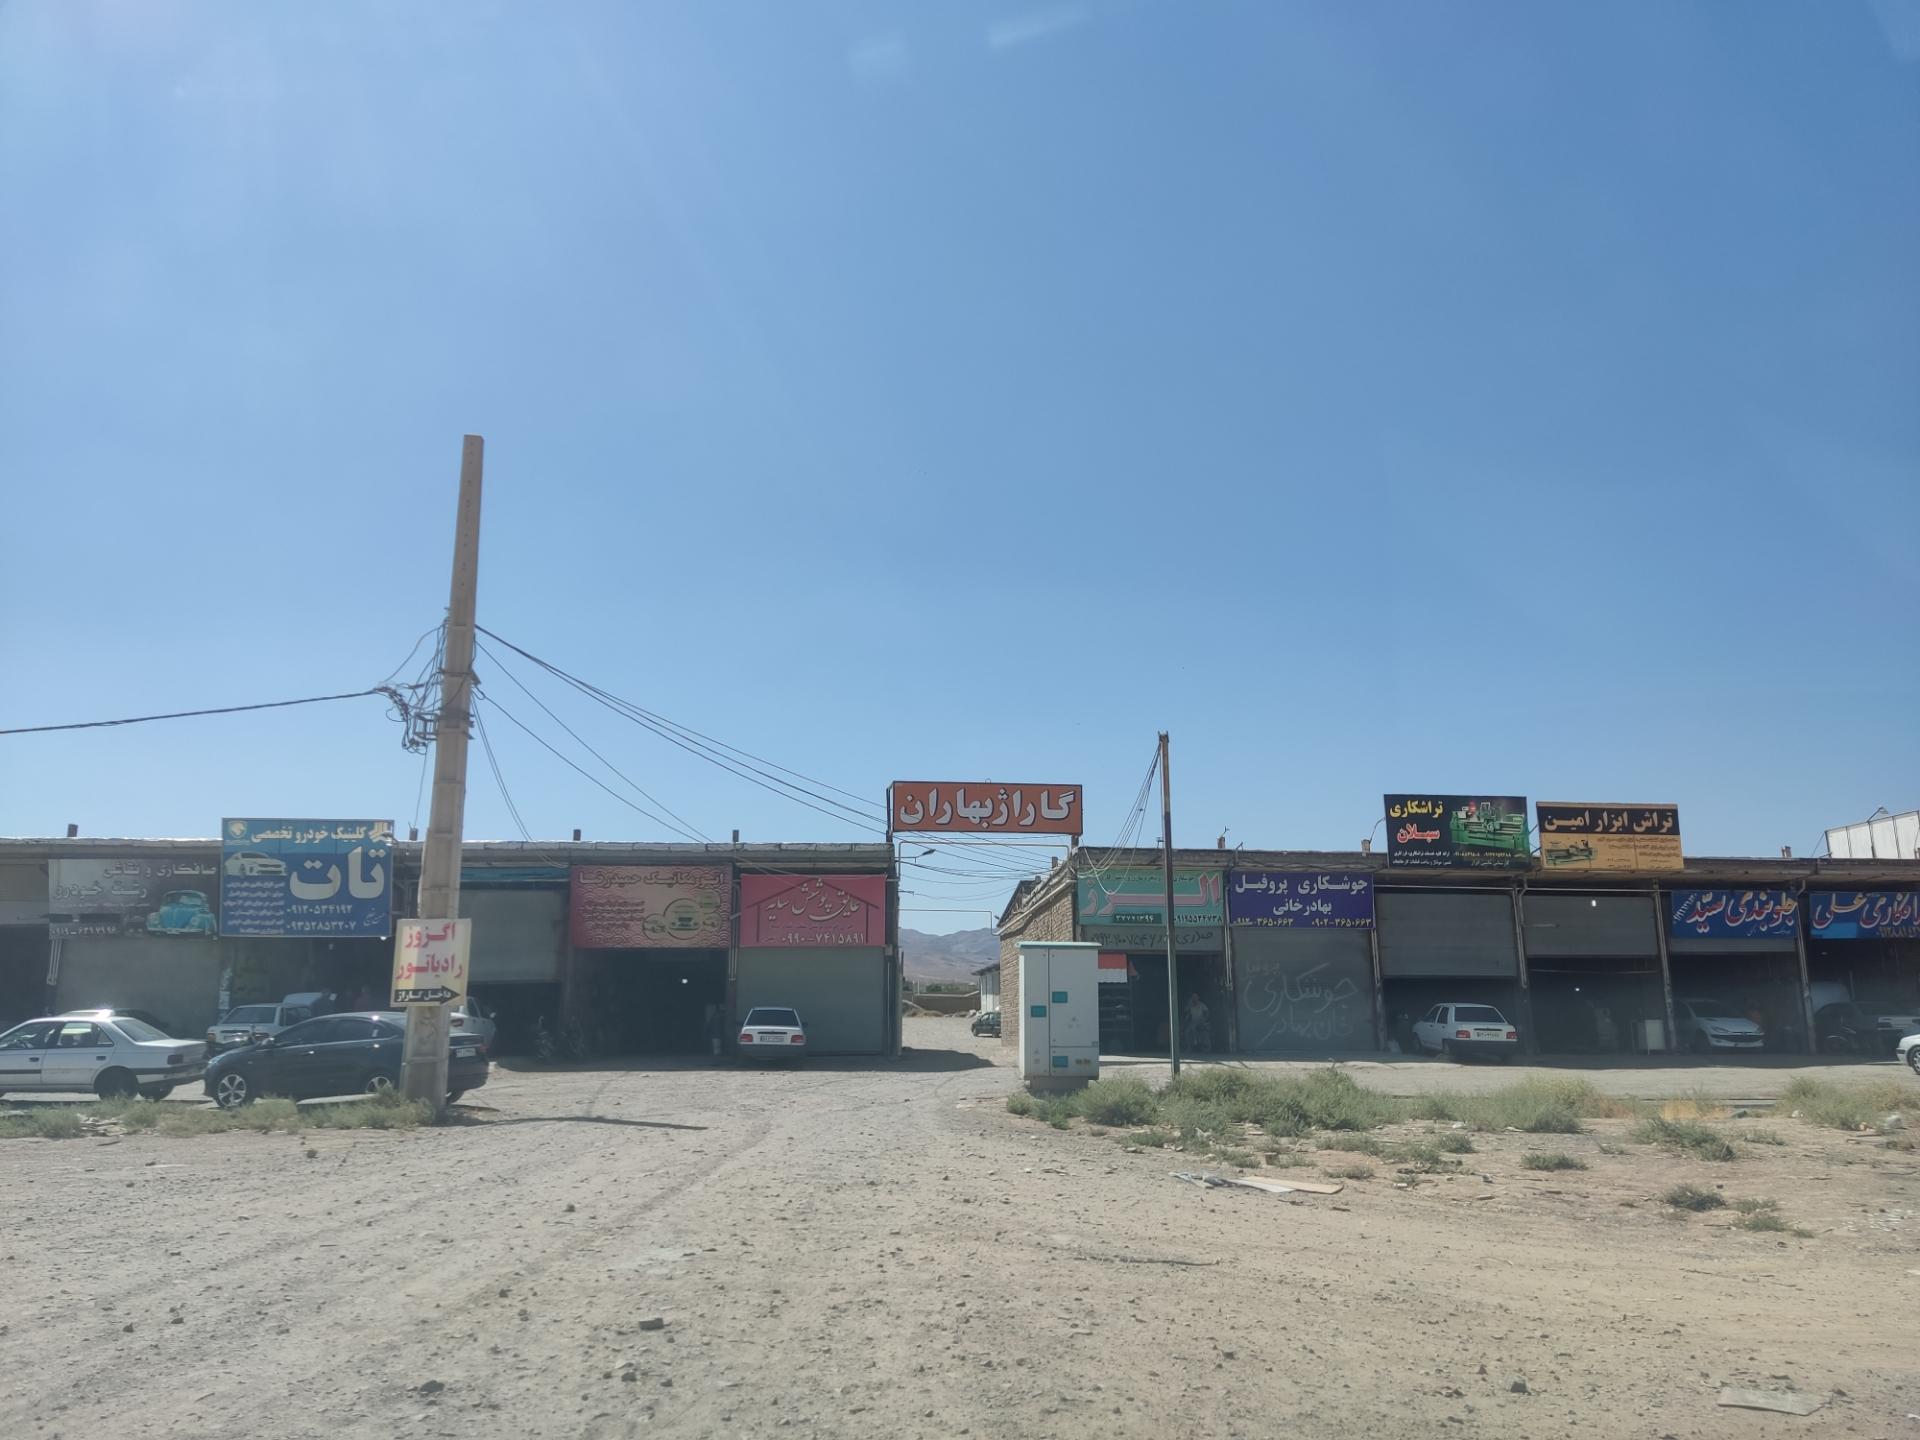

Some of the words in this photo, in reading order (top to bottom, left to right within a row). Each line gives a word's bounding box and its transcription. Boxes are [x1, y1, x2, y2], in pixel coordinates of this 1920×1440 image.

[899, 787, 994, 829] بهاران
[991, 787, 1077, 827] گاراژ
[1389, 799, 1443, 818] تراشکاری
[1544, 809, 1590, 831] امین
[1595, 810, 1628, 833] ابزار
[1633, 811, 1673, 833] تراش
[251, 825, 292, 843] تخصصی
[295, 825, 329, 844] خودرو
[331, 825, 367, 843] کلینیک
[1397, 823, 1441, 844] سبلان
[103, 861, 140, 879] نقاشی
[145, 867, 152, 878] و
[156, 862, 217, 879] صافکاری
[289, 846, 385, 900] تات
[1235, 874, 1288, 895] پروفیل
[1297, 875, 1368, 895] جوشکاری
[765, 896, 790, 921] سایه
[808, 889, 861, 921] عایق
[1725, 891, 1797, 931] جلوبندی
[1811, 892, 1868, 929] علی
[1859, 892, 1920, 929] افکاری
[405, 922, 456, 949] اگزوز
[395, 953, 463, 980] رادیاتور
[423, 990, 451, 1001] داخل
[1243, 961, 1360, 1016] جوشکاری
